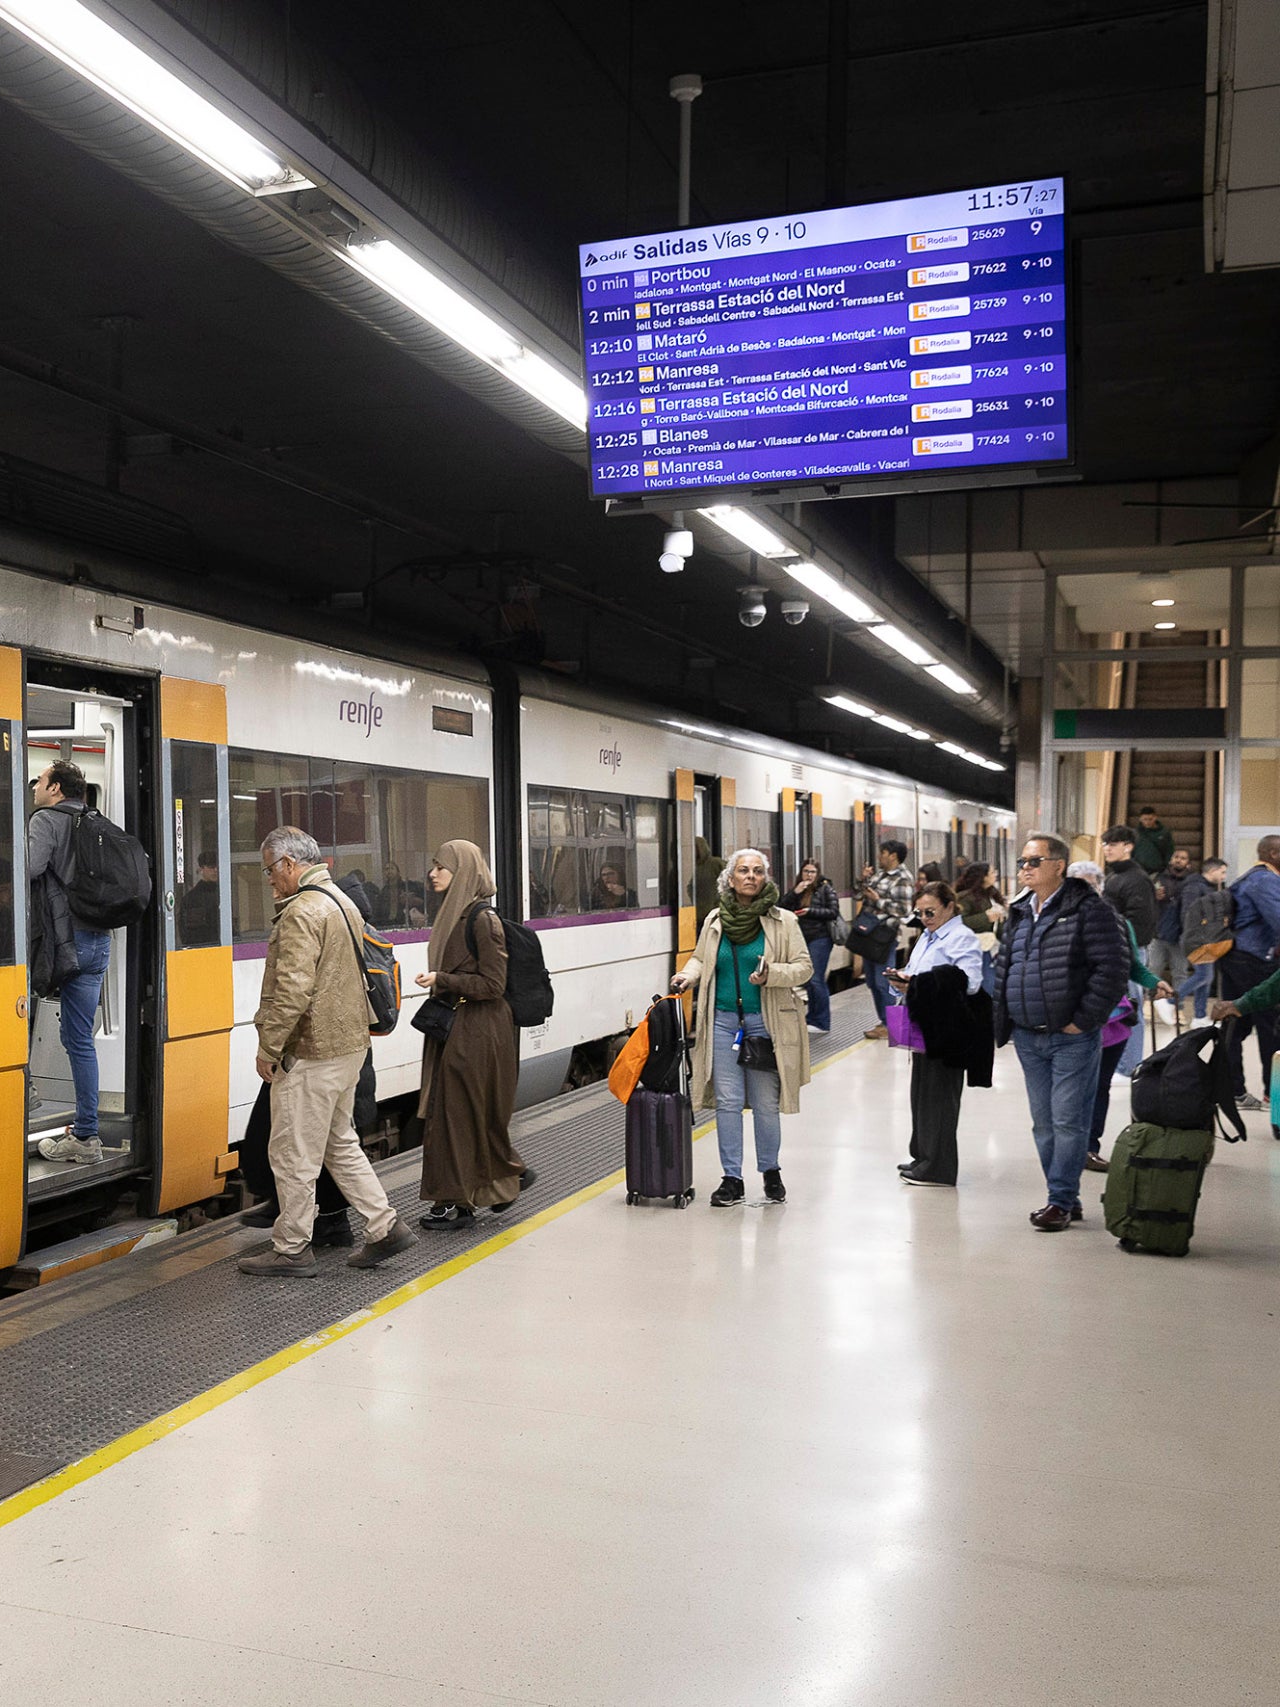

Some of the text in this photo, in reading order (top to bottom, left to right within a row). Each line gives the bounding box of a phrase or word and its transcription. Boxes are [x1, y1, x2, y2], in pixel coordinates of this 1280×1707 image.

[1028, 207, 1043, 216] Vía
[972, 227, 1006, 241] 25629
[1031, 221, 1042, 235] 9
[634, 221, 806, 260] Salidas Vías 9 10
[928, 235, 958, 244] Rodalia
[599, 250, 627, 262] adif
[928, 270, 959, 279] Rodalia
[973, 262, 1007, 275] 77622
[587, 279, 597, 292] 0
[602, 276, 628, 291] min
[652, 267, 710, 284] Portbou
[634, 259, 896, 299] adalona Montgat Montgat Nord El Masnou Ocata
[589, 311, 599, 324] 2
[604, 307, 630, 322] min
[653, 299, 715, 316] Terrassa
[718, 288, 774, 308] Estació
[778, 285, 803, 301] del
[806, 280, 845, 298] Nord
[653, 318, 671, 329] Sud
[678, 313, 720, 326] Sabadell
[722, 310, 756, 321] Centre
[763, 302, 807, 316] Sabadell
[808, 299, 834, 311] Nord
[841, 295, 885, 307] Terrassa
[887, 291, 904, 302] Est
[929, 305, 959, 313] Rodalia
[973, 297, 1007, 310] 25739
[591, 339, 632, 355] 12:10
[655, 329, 707, 348] Mataró
[638, 354, 647, 363] El
[648, 352, 669, 361] Clot
[675, 348, 698, 359] Sant
[699, 345, 725, 356] Adrià
[727, 344, 740, 353] de
[741, 340, 771, 352] Besòs
[778, 336, 825, 348] Badalona
[832, 329, 876, 342] Montgat
[930, 339, 960, 347] Rodalia
[974, 332, 1008, 344] 77422
[592, 370, 634, 387] 12:12
[656, 364, 719, 380] Manresa
[667, 381, 707, 391] Terrassa
[708, 377, 724, 387] Est
[731, 374, 772, 385] Terrassa
[774, 368, 811, 381] Estació
[812, 366, 829, 377] del
[831, 363, 856, 375] Nord
[864, 360, 888, 371] Sant
[931, 373, 961, 381] Rodalia
[975, 366, 1009, 378] 77624
[594, 402, 636, 418] 12:16
[658, 396, 719, 411] Terrassa
[723, 387, 778, 405] Estació
[782, 384, 807, 400] del
[810, 380, 848, 397] Nord
[976, 401, 1009, 412] 25631
[654, 415, 679, 424] Torre
[681, 409, 749, 422] Baró-Vallbona
[756, 402, 805, 415] Montcada
[807, 396, 859, 410] Bifurcació
[932, 407, 962, 415] Rodalia
[596, 433, 638, 449] 12:25
[660, 429, 709, 443] Blanes
[653, 446, 682, 456] Ocata
[688, 441, 721, 453] Premià
[723, 441, 736, 450] de
[737, 440, 757, 449] Mar
[763, 436, 803, 446] Vilassar
[804, 434, 818, 443] de
[819, 432, 839, 442] Mar
[846, 429, 888, 439] Cabrera
[890, 426, 904, 436] de
[933, 440, 963, 448] Rodalia
[976, 435, 1010, 446] 77424
[598, 464, 639, 479] 12:28
[662, 460, 723, 474] Manresa
[650, 477, 673, 487] Nord
[680, 476, 701, 485] Sant
[703, 472, 736, 484] Miquel
[737, 472, 750, 481] de
[752, 470, 797, 480] Gonteres
[804, 462, 871, 475] Viladecavalls
[339, 691, 383, 738] renfe
[599, 741, 622, 775] renfe
